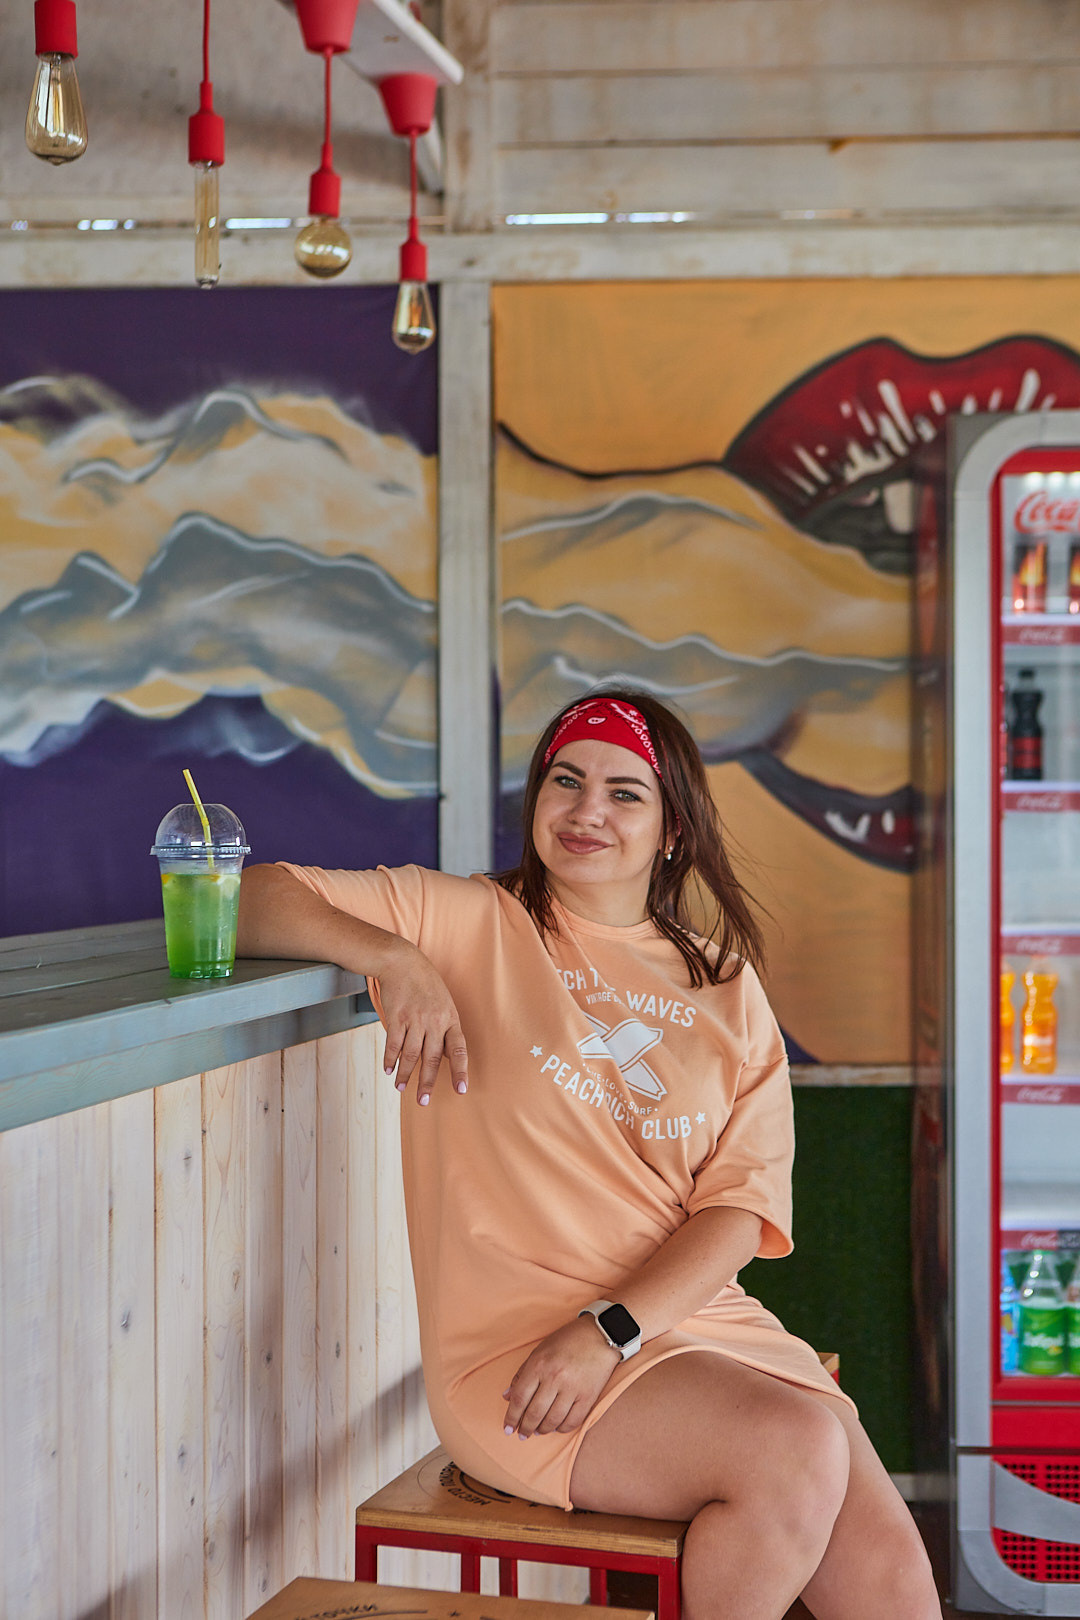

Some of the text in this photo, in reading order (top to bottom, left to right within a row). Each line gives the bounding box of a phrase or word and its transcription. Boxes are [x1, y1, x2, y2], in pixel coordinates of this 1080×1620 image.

[557, 968, 587, 990] CH
[626, 990, 697, 1028] WAVES
[540, 1054, 605, 1108] PEACH
[641, 1115, 692, 1140] CLUB
[628, 1101, 652, 1115] SURF
